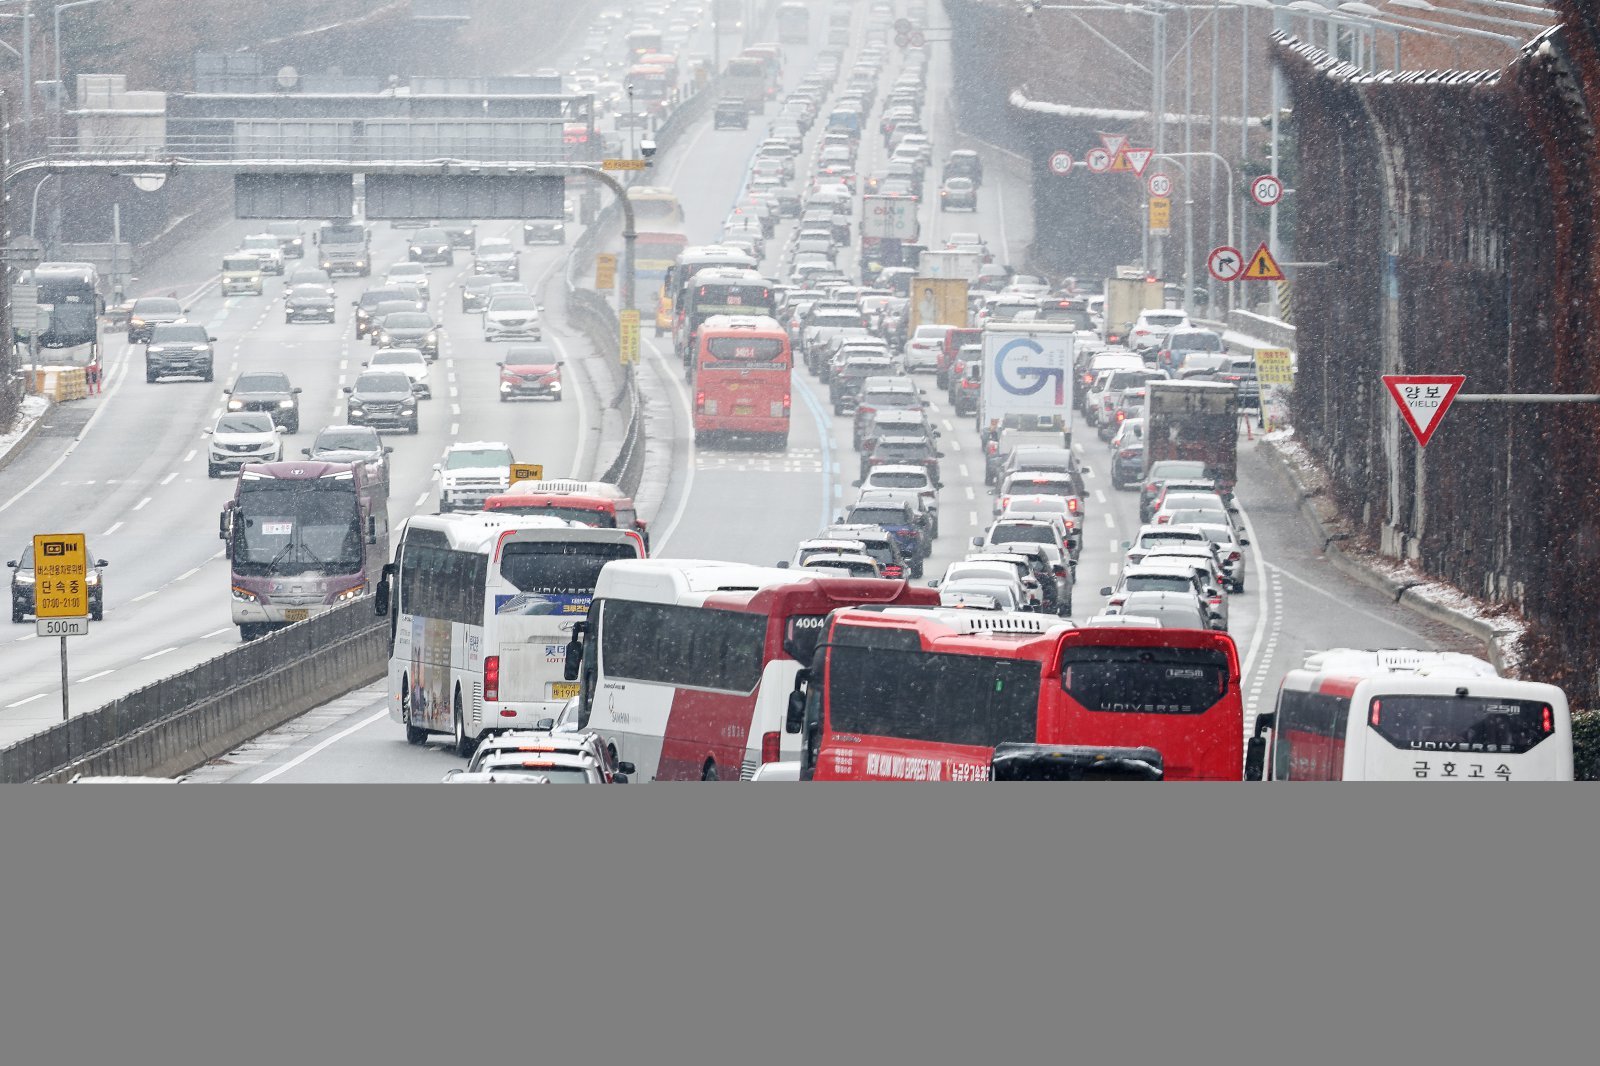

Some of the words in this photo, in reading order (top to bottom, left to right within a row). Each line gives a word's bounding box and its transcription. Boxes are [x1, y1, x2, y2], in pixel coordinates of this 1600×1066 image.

[1153, 180, 1169, 192] 80
[1259, 184, 1277, 198] 80
[1405, 386, 1441, 399] 양보
[37, 564, 84, 575] 버스전용차로위반
[42, 580, 79, 594] 단속중
[532, 586, 595, 594] UNIVERS
[47, 621, 79, 634] 500m
[796, 617, 825, 629] 4004
[545, 645, 567, 657] 롯데
[1100, 702, 1192, 712] UNIVERSE
[1410, 741, 1512, 752] UNIVERSE
[1413, 761, 1512, 781] 금호고속
